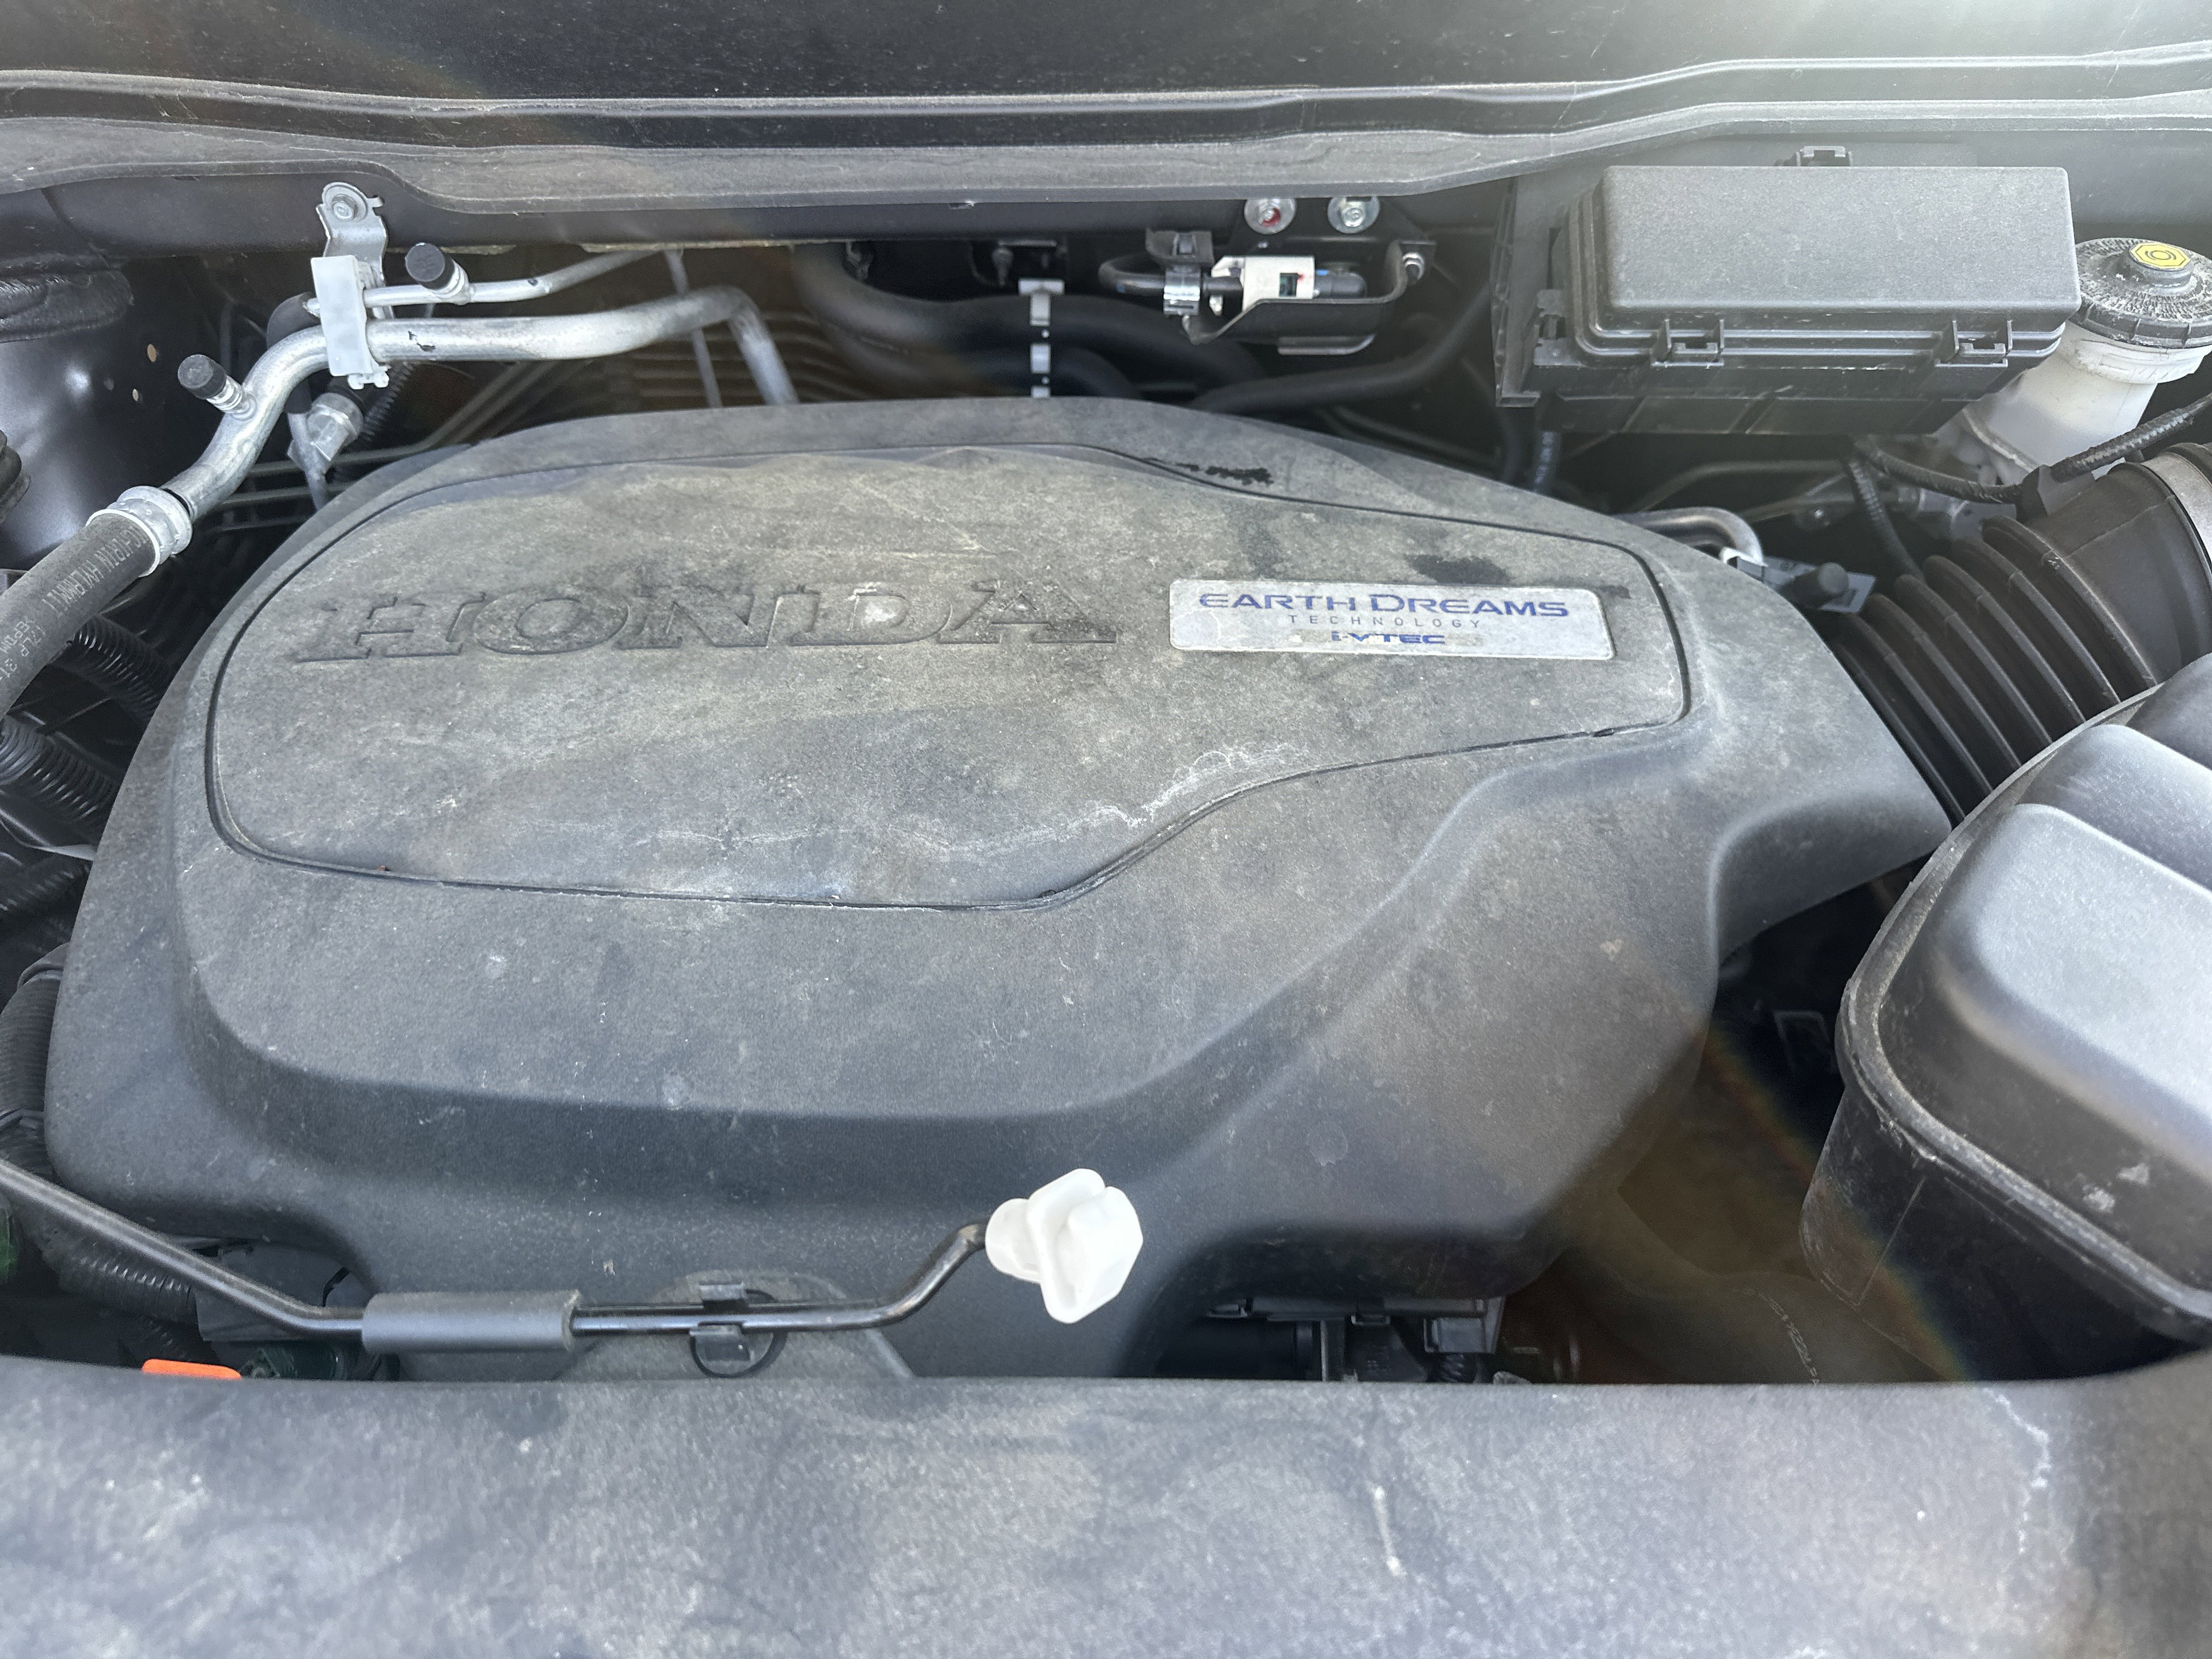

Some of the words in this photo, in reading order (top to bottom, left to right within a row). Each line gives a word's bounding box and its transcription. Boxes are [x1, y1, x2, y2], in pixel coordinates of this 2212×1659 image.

[1199, 593, 1356, 611] EARTH
[1369, 594, 1568, 617] DREAMS
[291, 577, 1118, 662] HONDA
[1289, 614, 1480, 628] TECHNOLOGY
